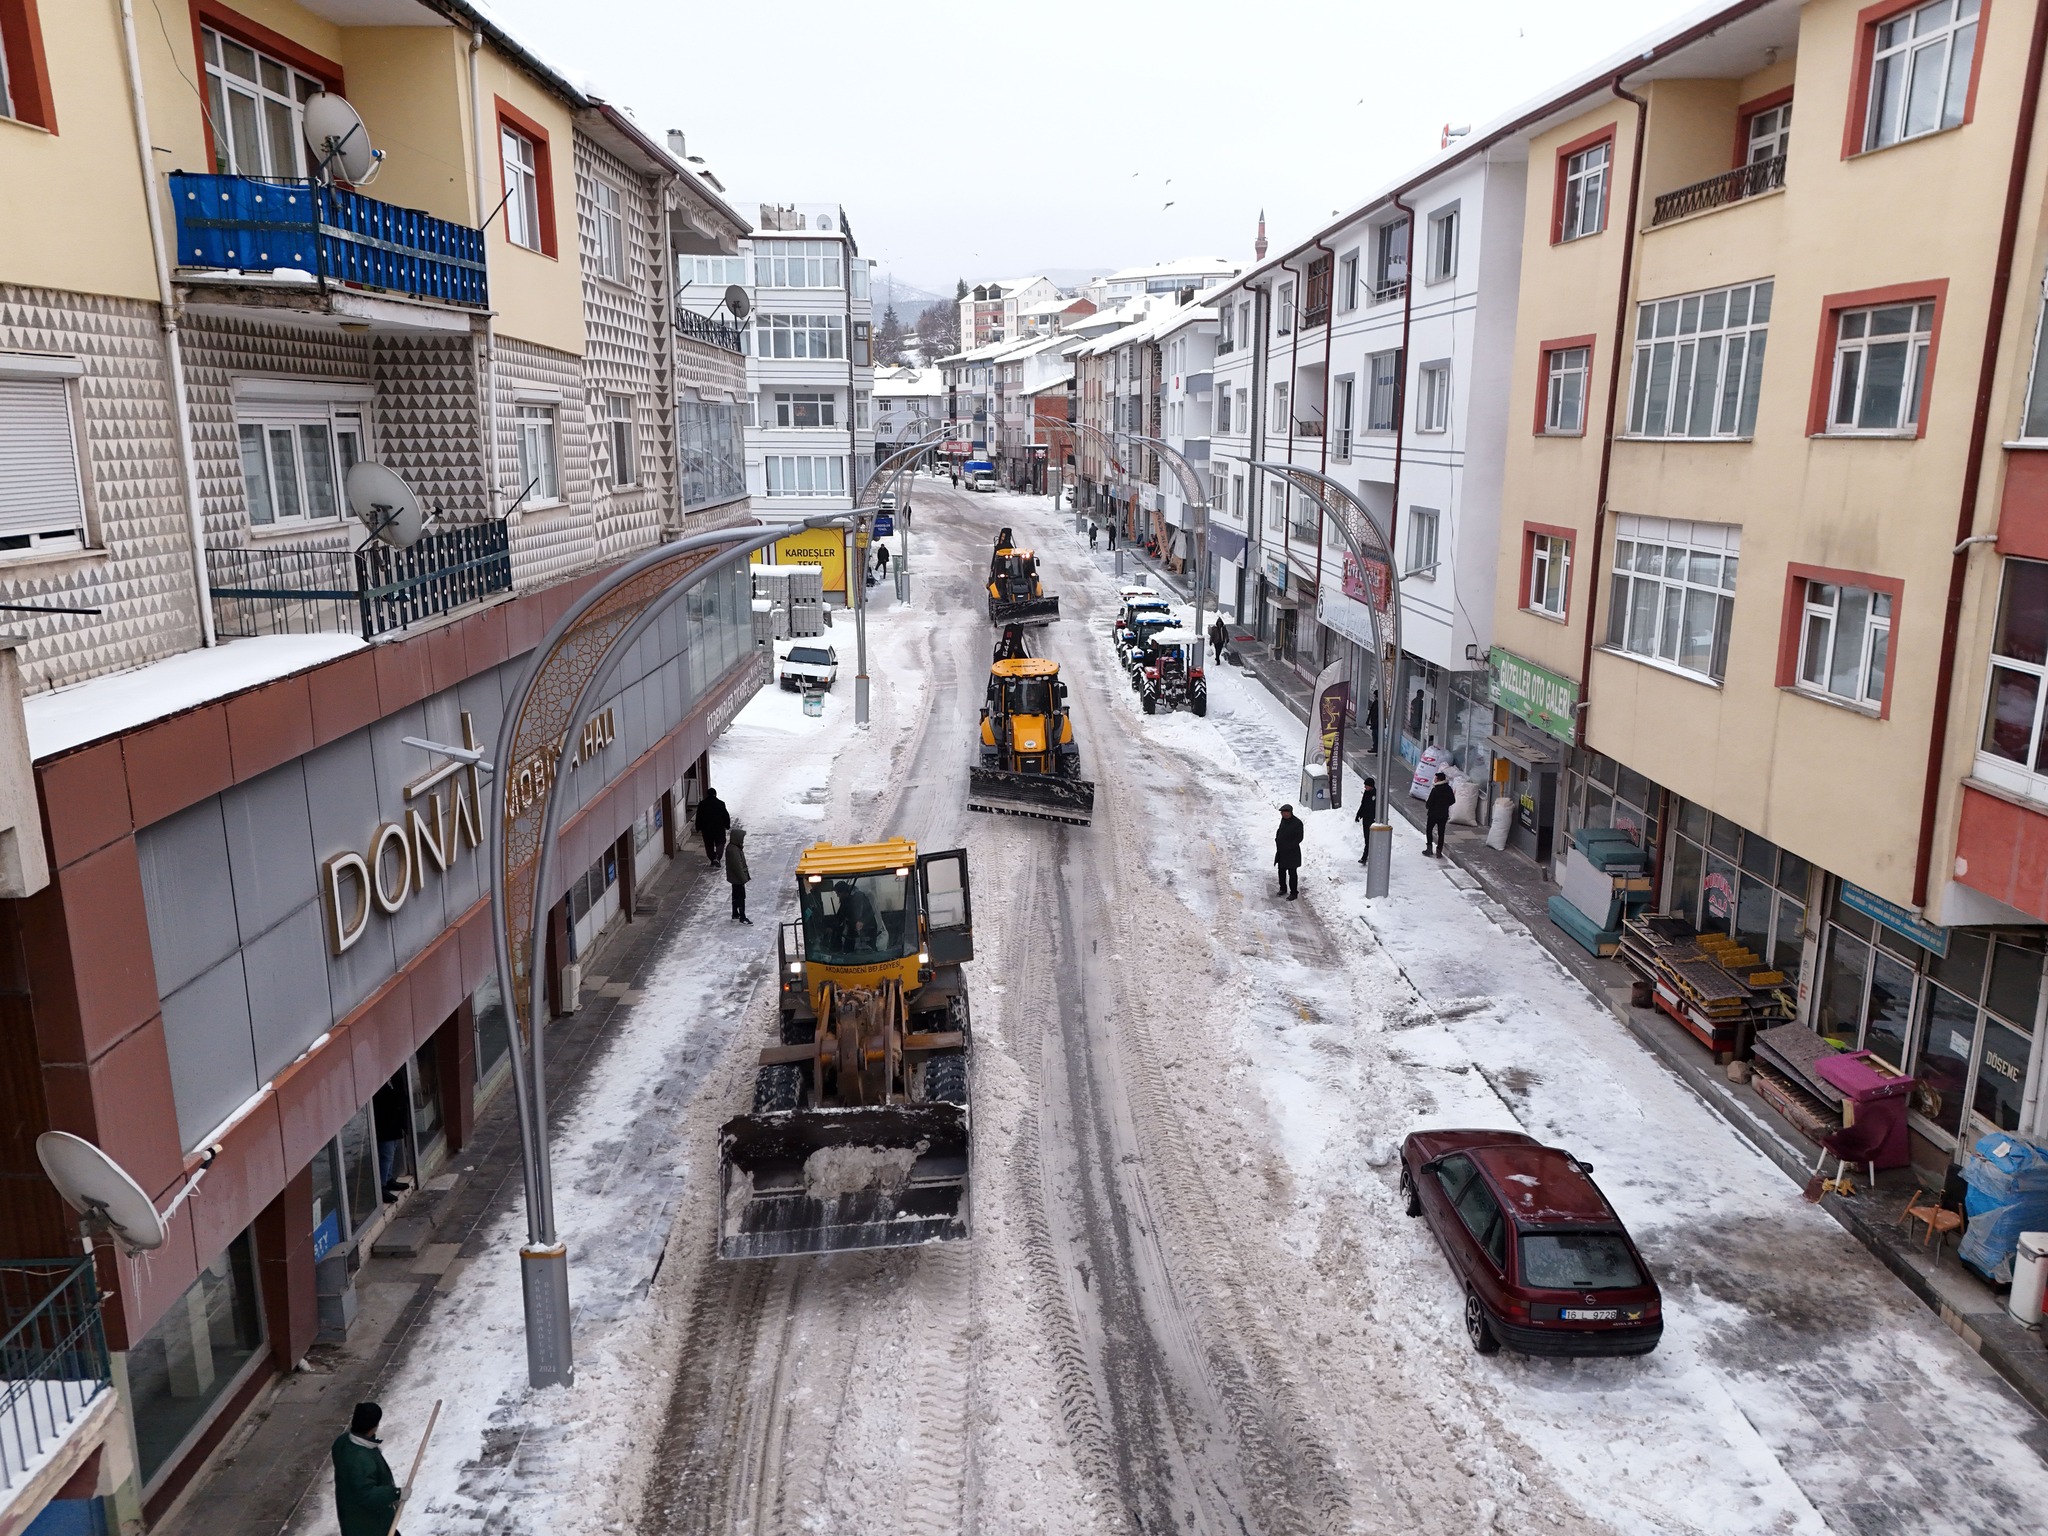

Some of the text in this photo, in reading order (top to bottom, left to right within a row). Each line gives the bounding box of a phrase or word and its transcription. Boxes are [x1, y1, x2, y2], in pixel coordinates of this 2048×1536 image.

[785, 549, 835, 559] KARDEŞLER
[1500, 655, 1571, 720] GÜZELLER OTO GALERİ
[1986, 1050, 2020, 1083] DÖŞEME
[1567, 1311, 1617, 1320] 16 L 9728
[538, 1365, 556, 1373] 2021
